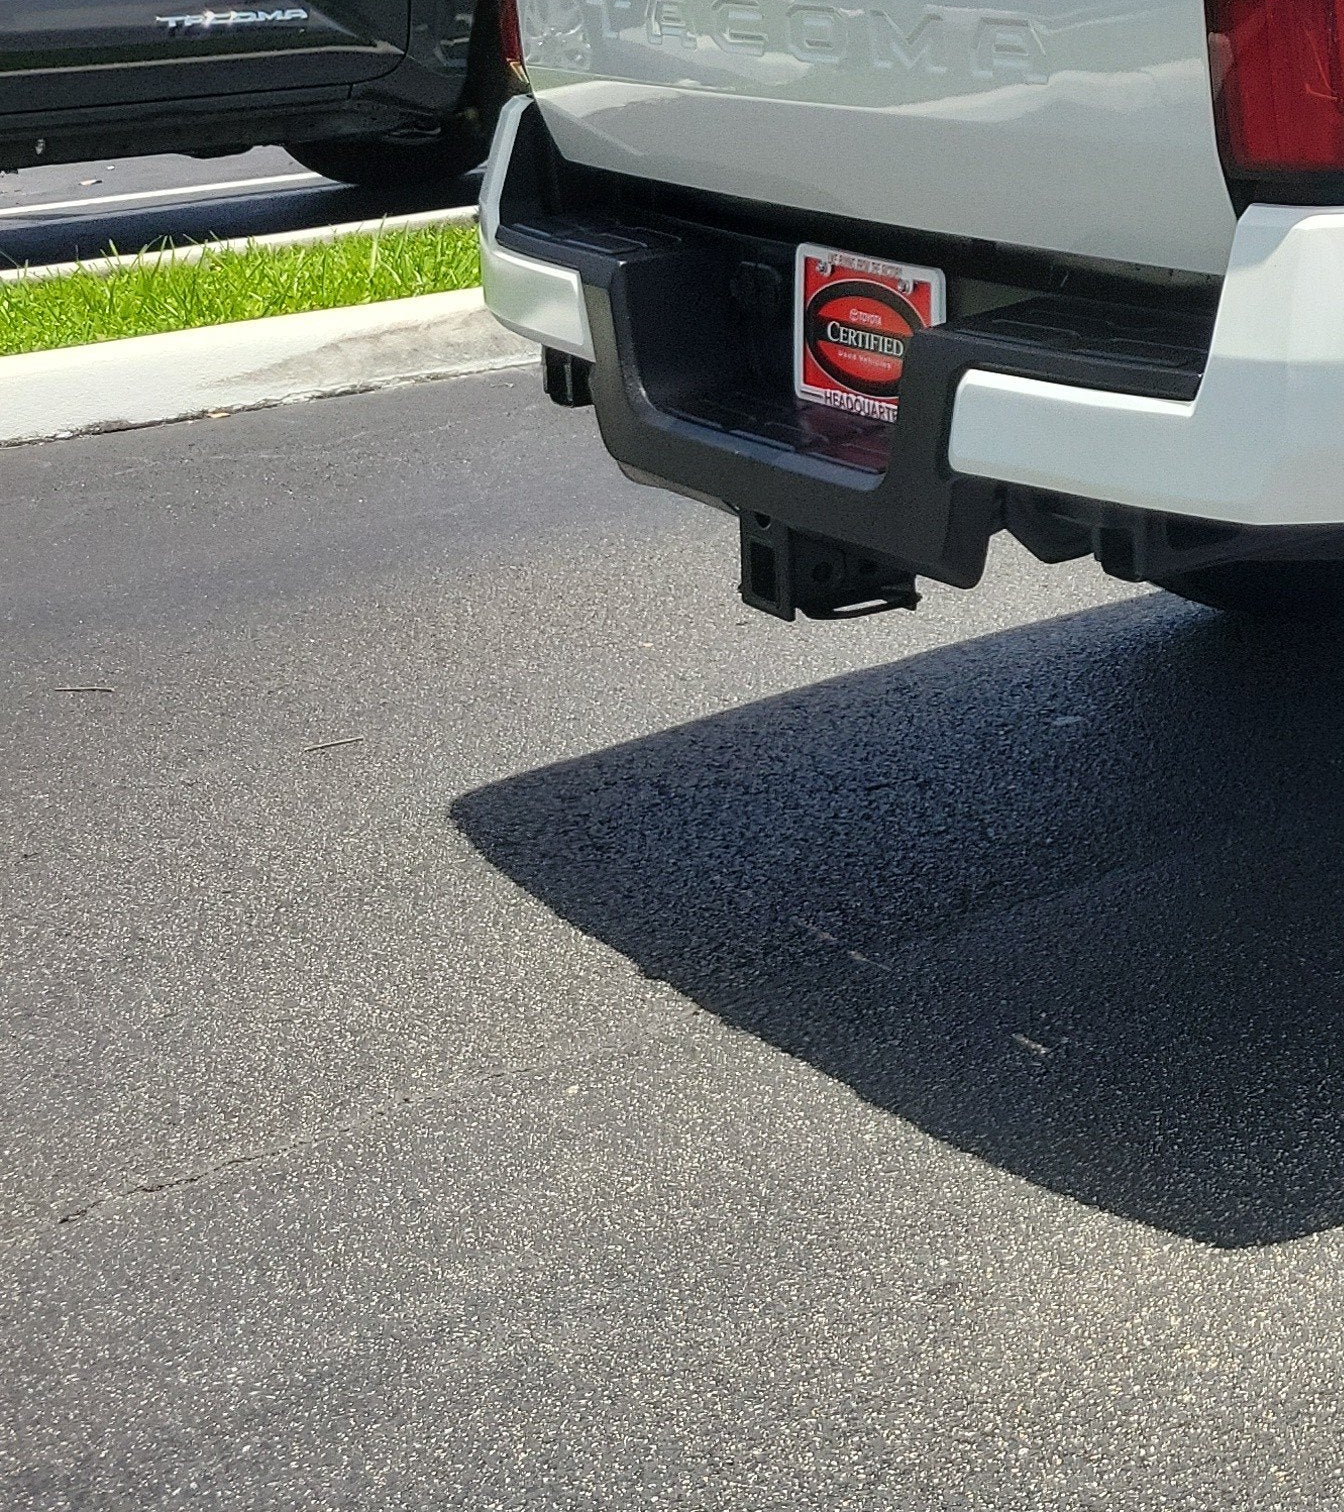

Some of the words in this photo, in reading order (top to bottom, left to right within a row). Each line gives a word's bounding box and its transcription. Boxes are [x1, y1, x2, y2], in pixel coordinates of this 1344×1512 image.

[156, 8, 308, 28] TACOMA
[827, 320, 904, 357] CERTIFIED
[824, 389, 898, 423] HEADQUARTE
